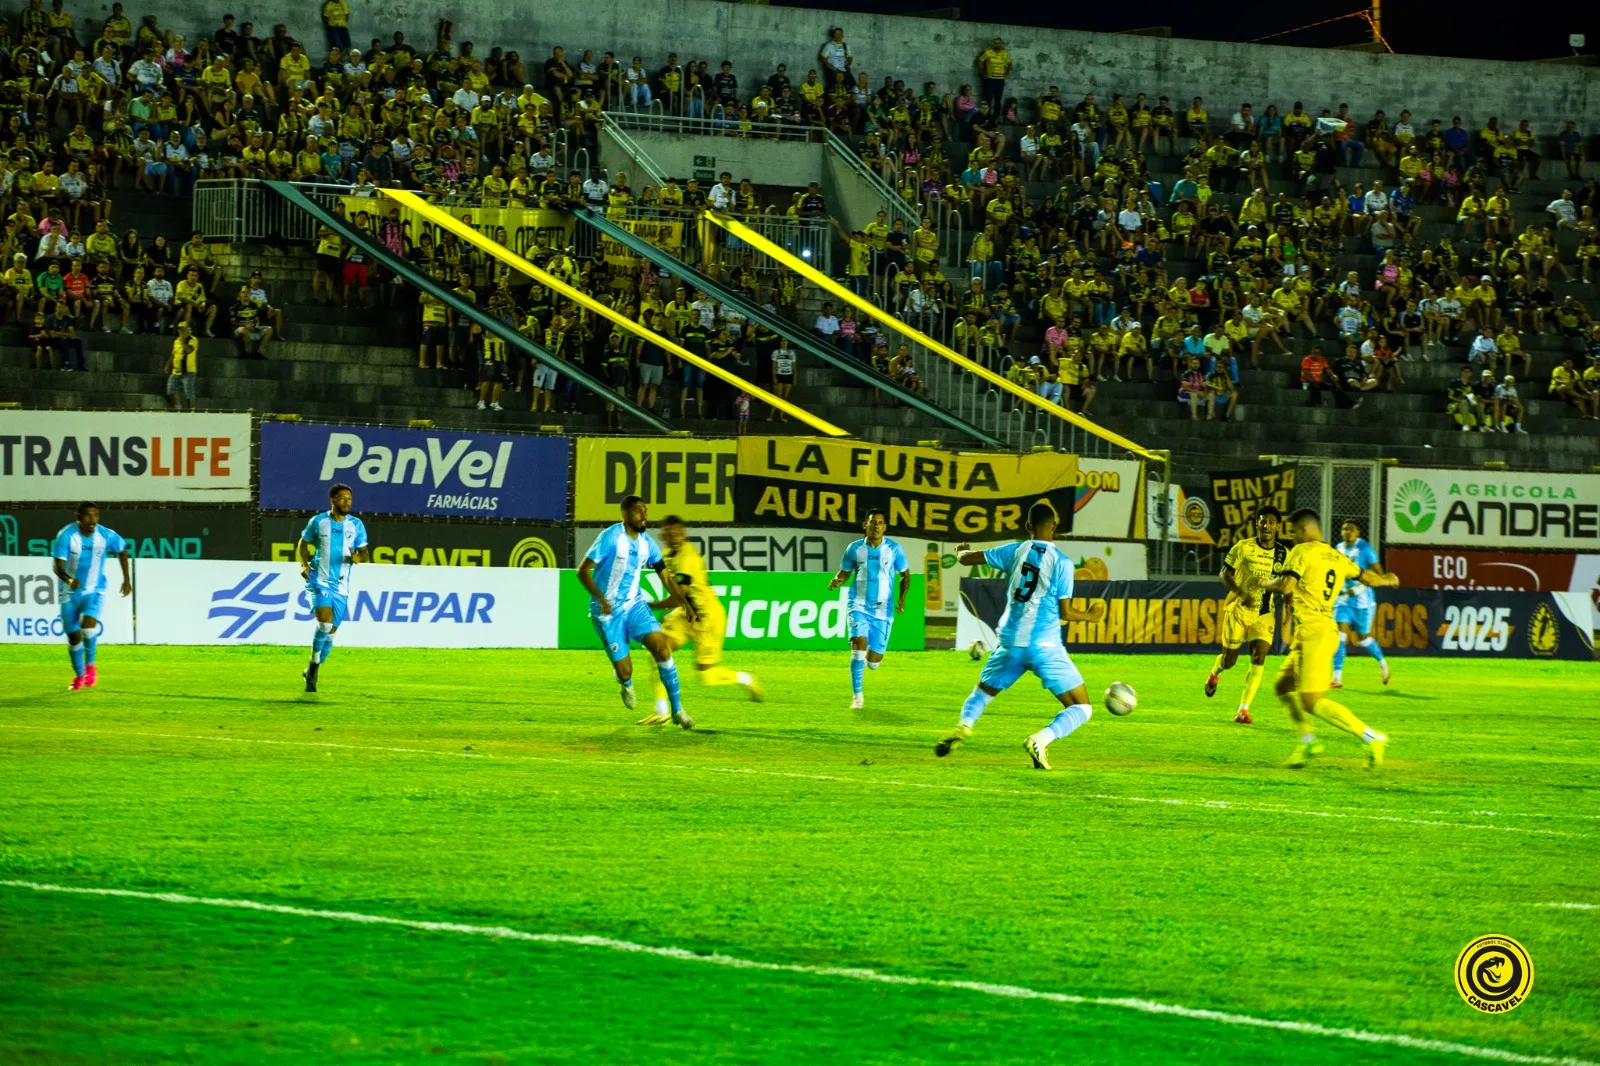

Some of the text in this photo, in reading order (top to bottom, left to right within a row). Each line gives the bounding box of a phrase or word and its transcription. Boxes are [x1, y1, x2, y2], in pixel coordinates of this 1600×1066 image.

[0, 436, 231, 476] TRANSLIFE
[319, 432, 513, 489] PanVel
[767, 440, 1000, 492] LA FURIA
[427, 492, 499, 511] FARMÁCIAS
[754, 486, 856, 523] AURI
[1448, 482, 1577, 499] AGRÍCOLA
[1442, 500, 1598, 538] ANDRE
[1014, 561, 1041, 603] 3
[1322, 568, 1337, 602] 9
[1433, 555, 1468, 579] ECO
[294, 590, 496, 623] SNEPAR
[1442, 605, 1512, 651] 2025
